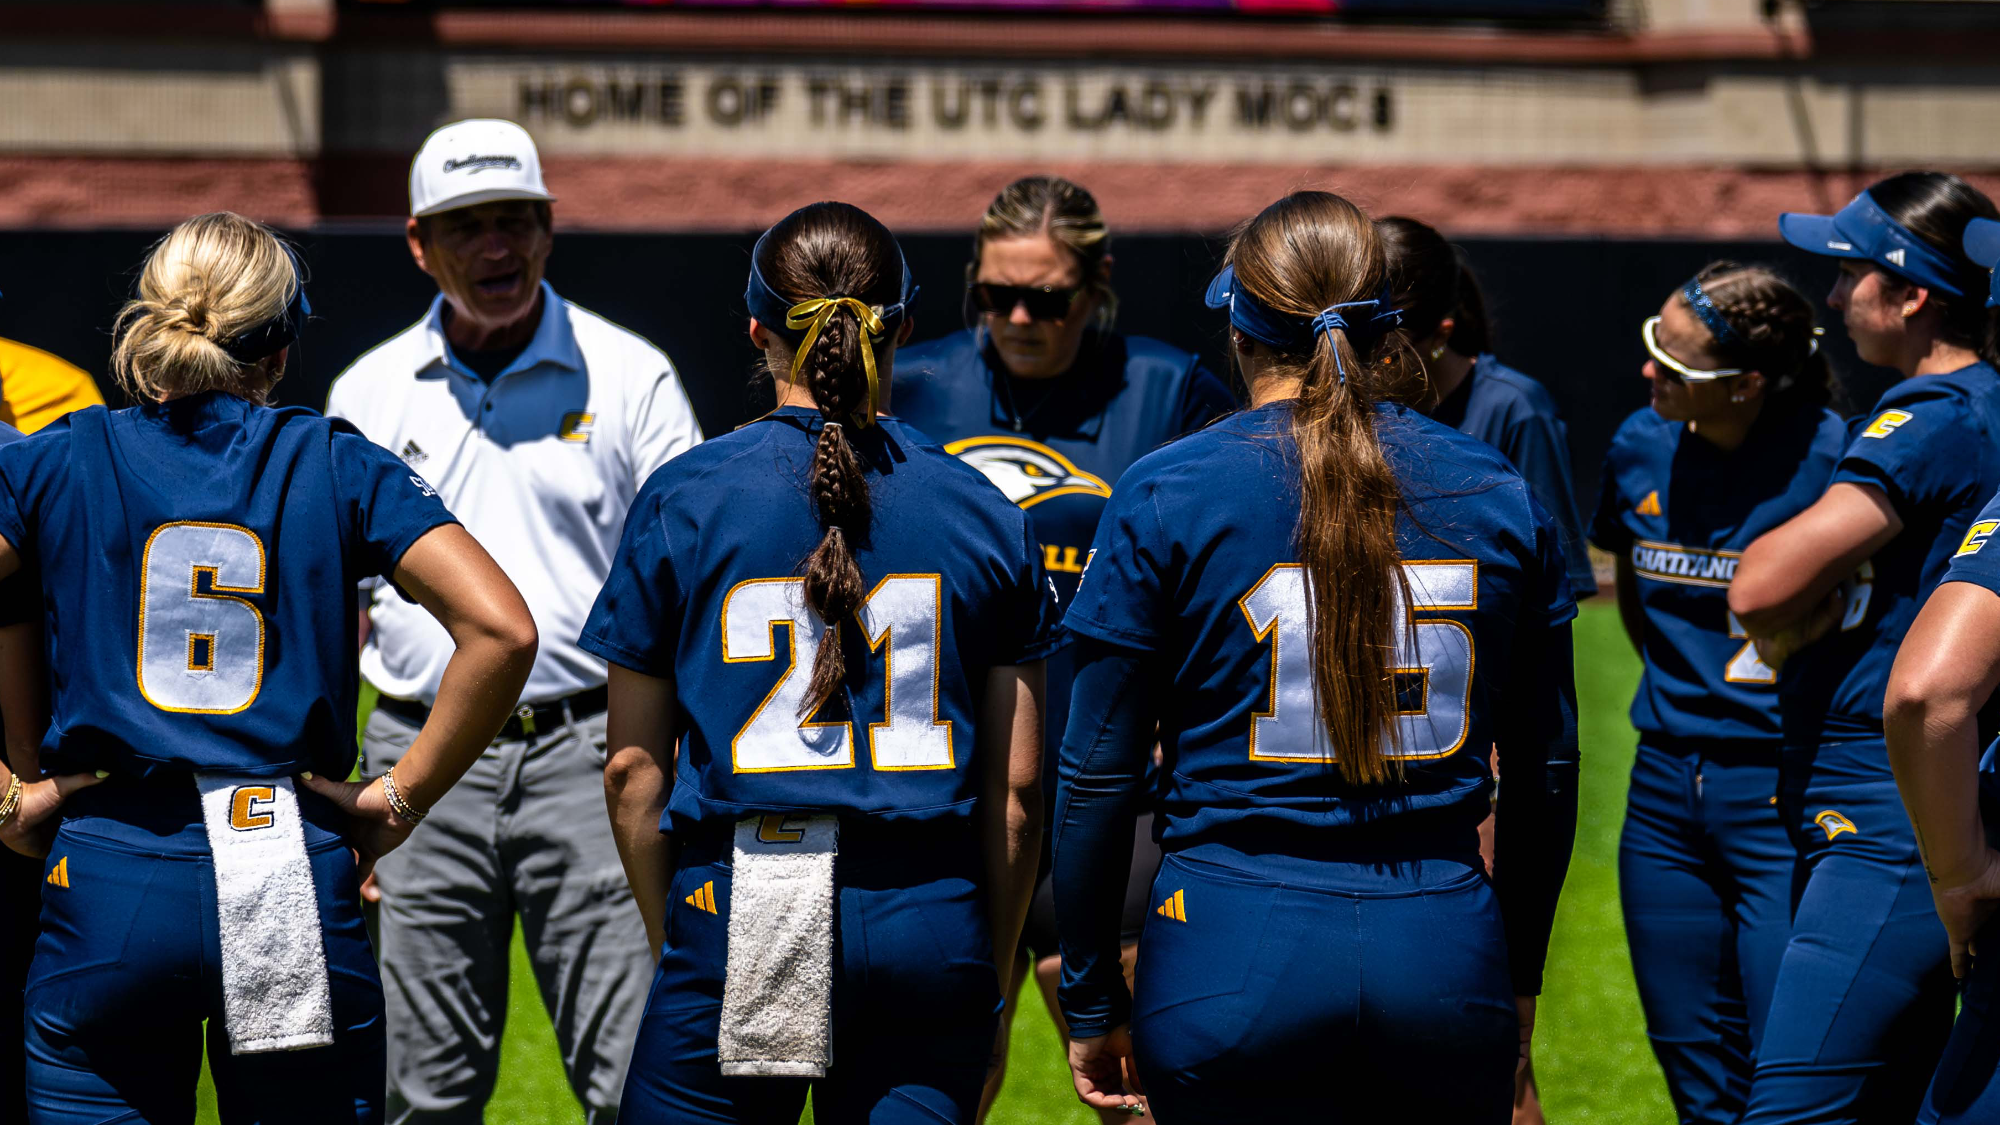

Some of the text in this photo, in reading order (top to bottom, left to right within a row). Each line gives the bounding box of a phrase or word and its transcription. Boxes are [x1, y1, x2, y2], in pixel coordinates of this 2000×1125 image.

[518, 78, 684, 130] HOME
[706, 76, 780, 129] OF
[806, 78, 912, 132] THE
[933, 80, 1044, 132] UTC
[1066, 82, 1216, 132] LADY
[137, 519, 266, 715] 6
[721, 573, 956, 774] 21
[1237, 558, 1478, 764] 15
[228, 783, 276, 832] C
